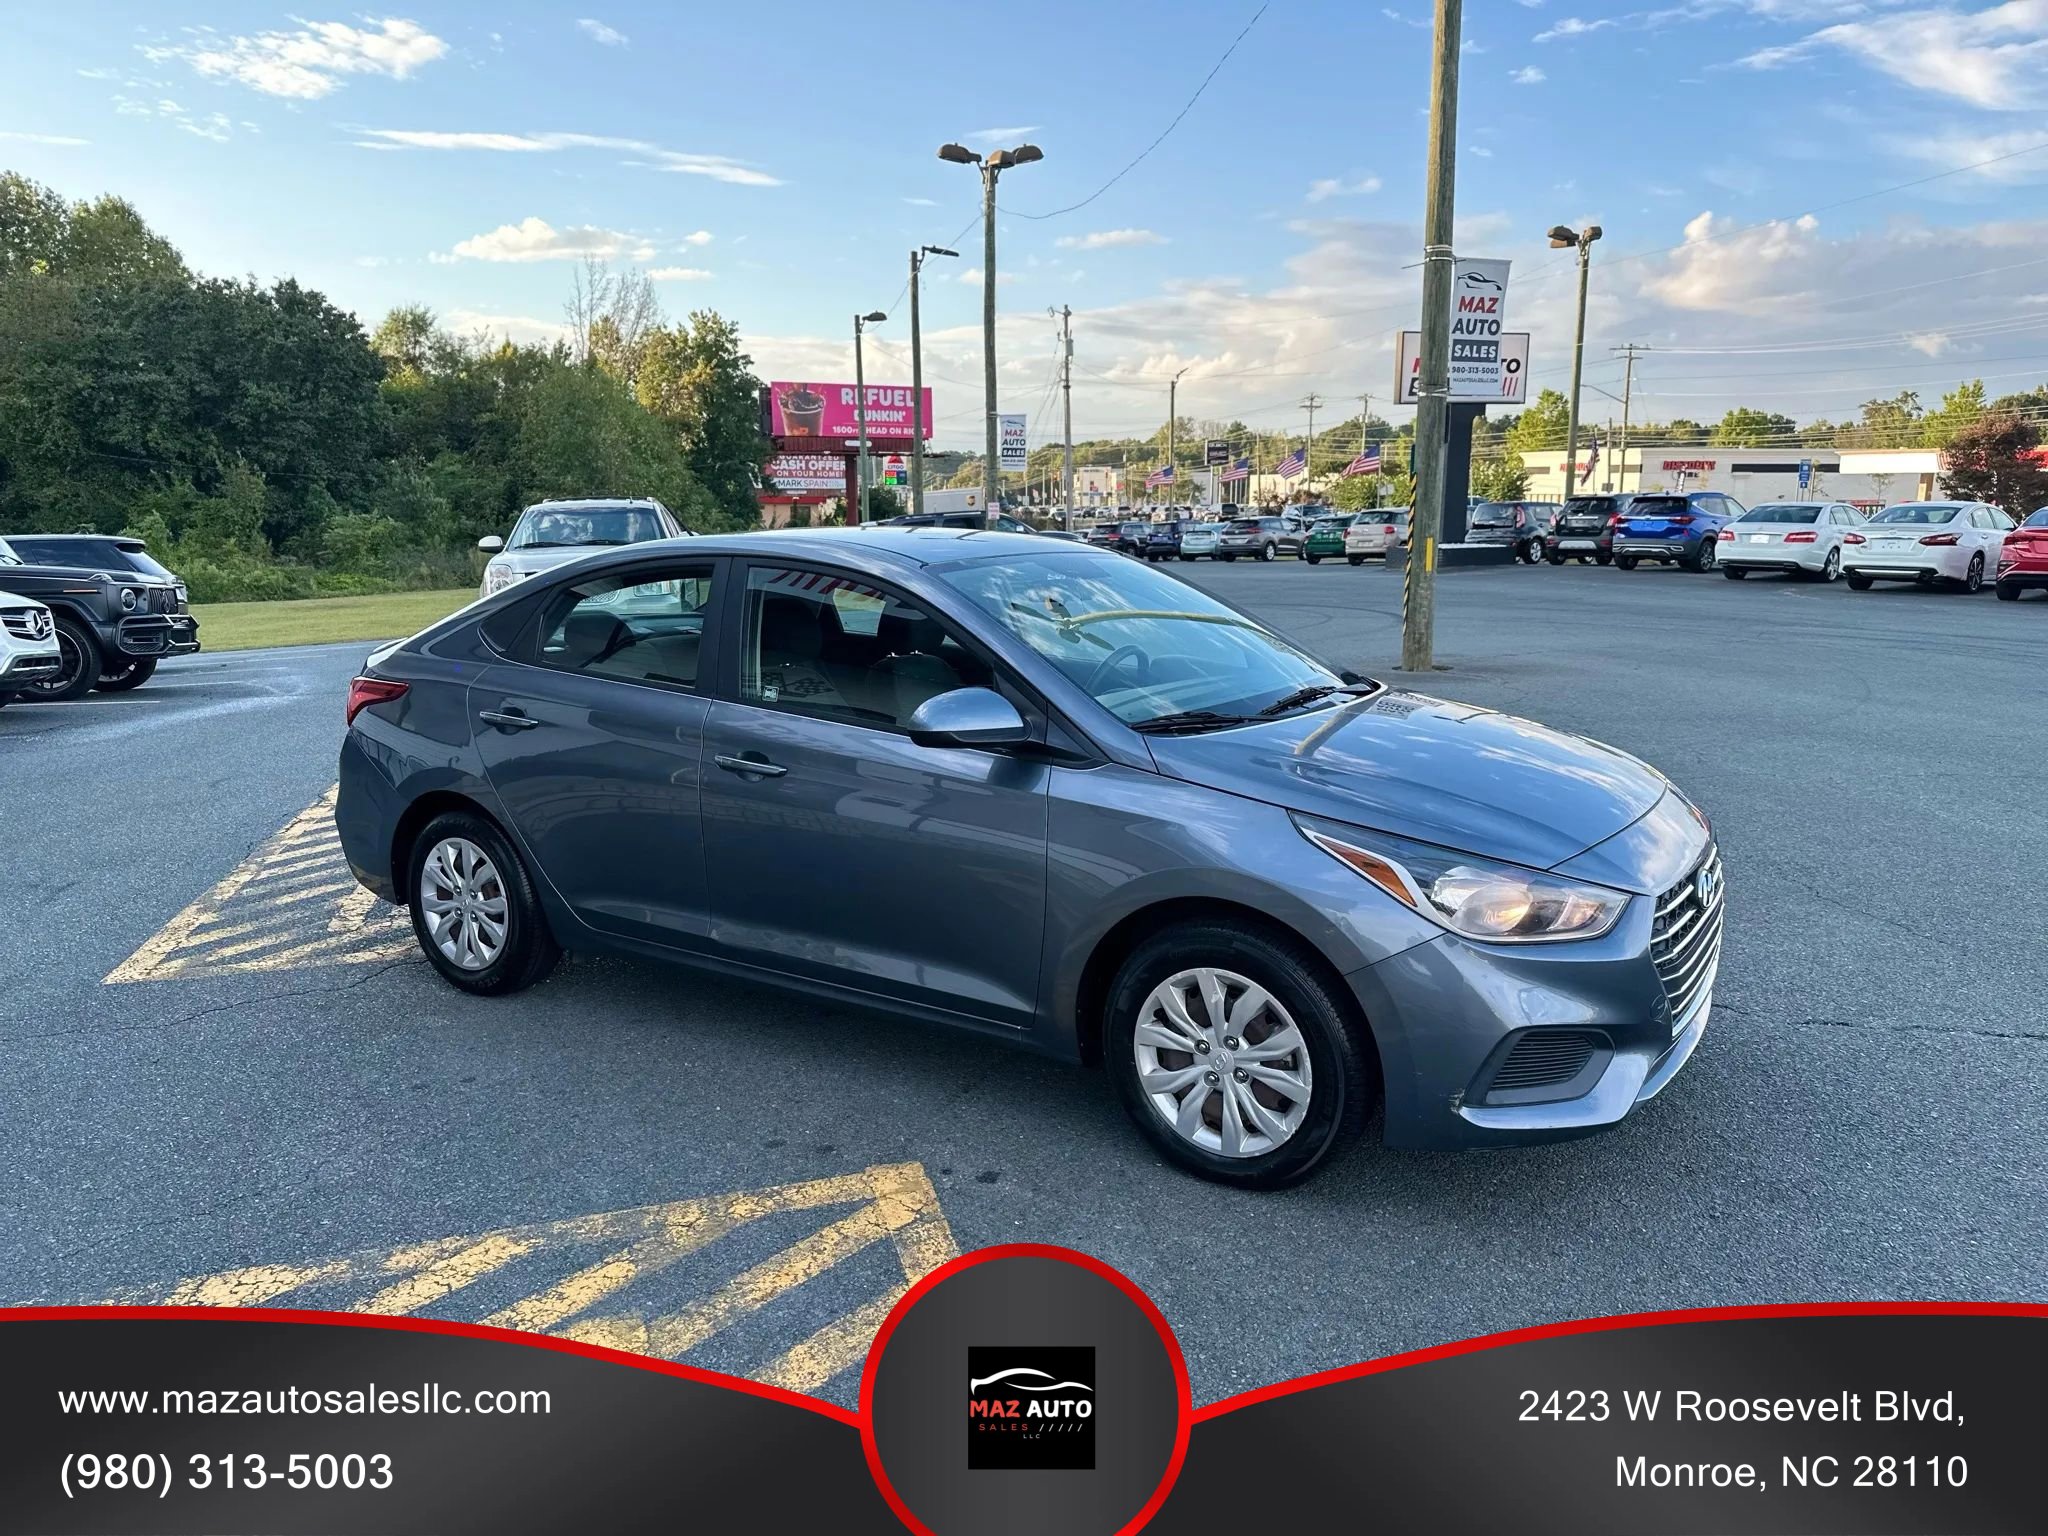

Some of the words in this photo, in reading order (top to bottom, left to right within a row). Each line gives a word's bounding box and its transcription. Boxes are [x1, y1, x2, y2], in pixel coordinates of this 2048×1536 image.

[1458, 296, 1499, 313] MAZ
[1452, 318, 1500, 336] AUTO
[1454, 345, 1496, 358] SALES
[1452, 366, 1498, 374] 980-313-5003
[863, 427, 889, 435] HEAD
